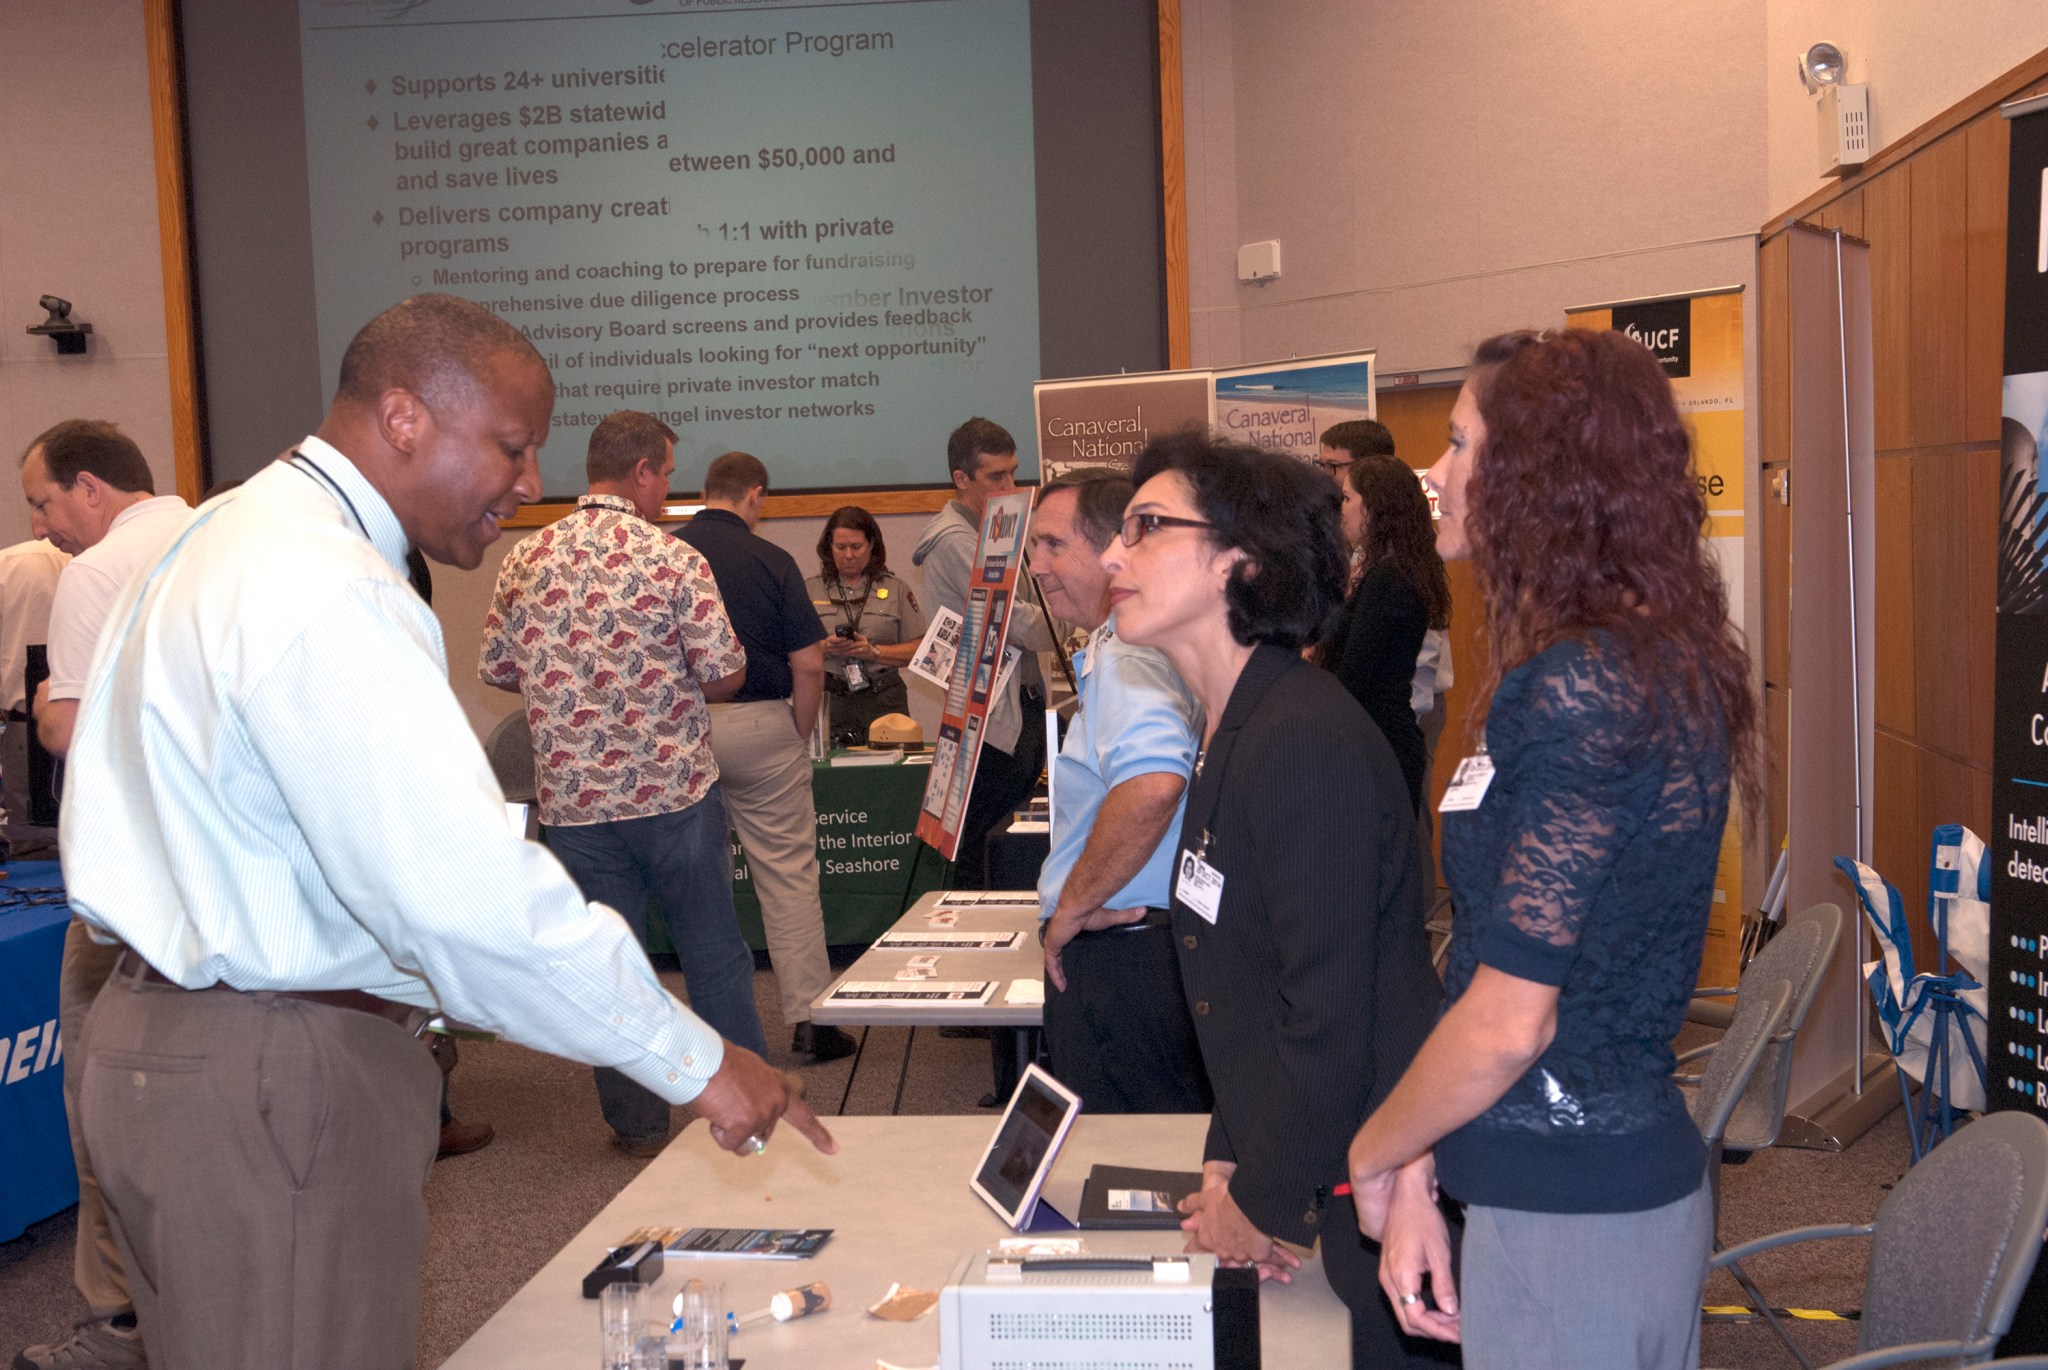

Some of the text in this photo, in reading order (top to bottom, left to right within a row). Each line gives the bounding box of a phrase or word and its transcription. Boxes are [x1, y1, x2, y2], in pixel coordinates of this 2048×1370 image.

[786, 31, 894, 57] Program
[392, 72, 496, 98] Supports
[504, 70, 544, 91] 24+
[393, 107, 511, 134] Leverages
[519, 104, 563, 127] $2B
[395, 140, 451, 161] build
[459, 137, 517, 162] great
[524, 133, 649, 158] companies
[758, 146, 845, 171] $50,000
[853, 144, 896, 164] and
[396, 166, 559, 190] and save lives
[399, 203, 490, 226] Delivers
[499, 200, 603, 225] company
[718, 222, 751, 241] 1:1
[760, 220, 807, 241] with
[815, 216, 894, 243] private
[400, 234, 509, 260] programs
[433, 251, 915, 286] Mentoring and coaching to prepare for fundraising
[590, 292, 625, 309] due
[631, 290, 717, 309] diligence
[723, 287, 800, 307] process
[898, 284, 993, 306] Investor
[609, 320, 666, 338] Board
[672, 316, 748, 334] screens
[754, 314, 789, 331] and
[795, 311, 878, 333] provides
[885, 308, 972, 327] feedback
[1642, 329, 1679, 350] UCF
[565, 352, 584, 368] of
[590, 348, 693, 368] individuals
[699, 346, 769, 364] looking
[776, 343, 802, 360] for
[554, 370, 880, 399] that require private investor match
[705, 404, 782, 422] investor
[788, 400, 875, 419] networks
[1227, 395, 1310, 429] Canaveral
[1689, 398, 1721, 406] ORLANDO,
[1048, 406, 1142, 437] Canaveral
[1250, 418, 1316, 448] National
[1072, 428, 1148, 458] National
[819, 834, 846, 850] the
[852, 831, 912, 849] Interior
[825, 857, 900, 875] Seashore
